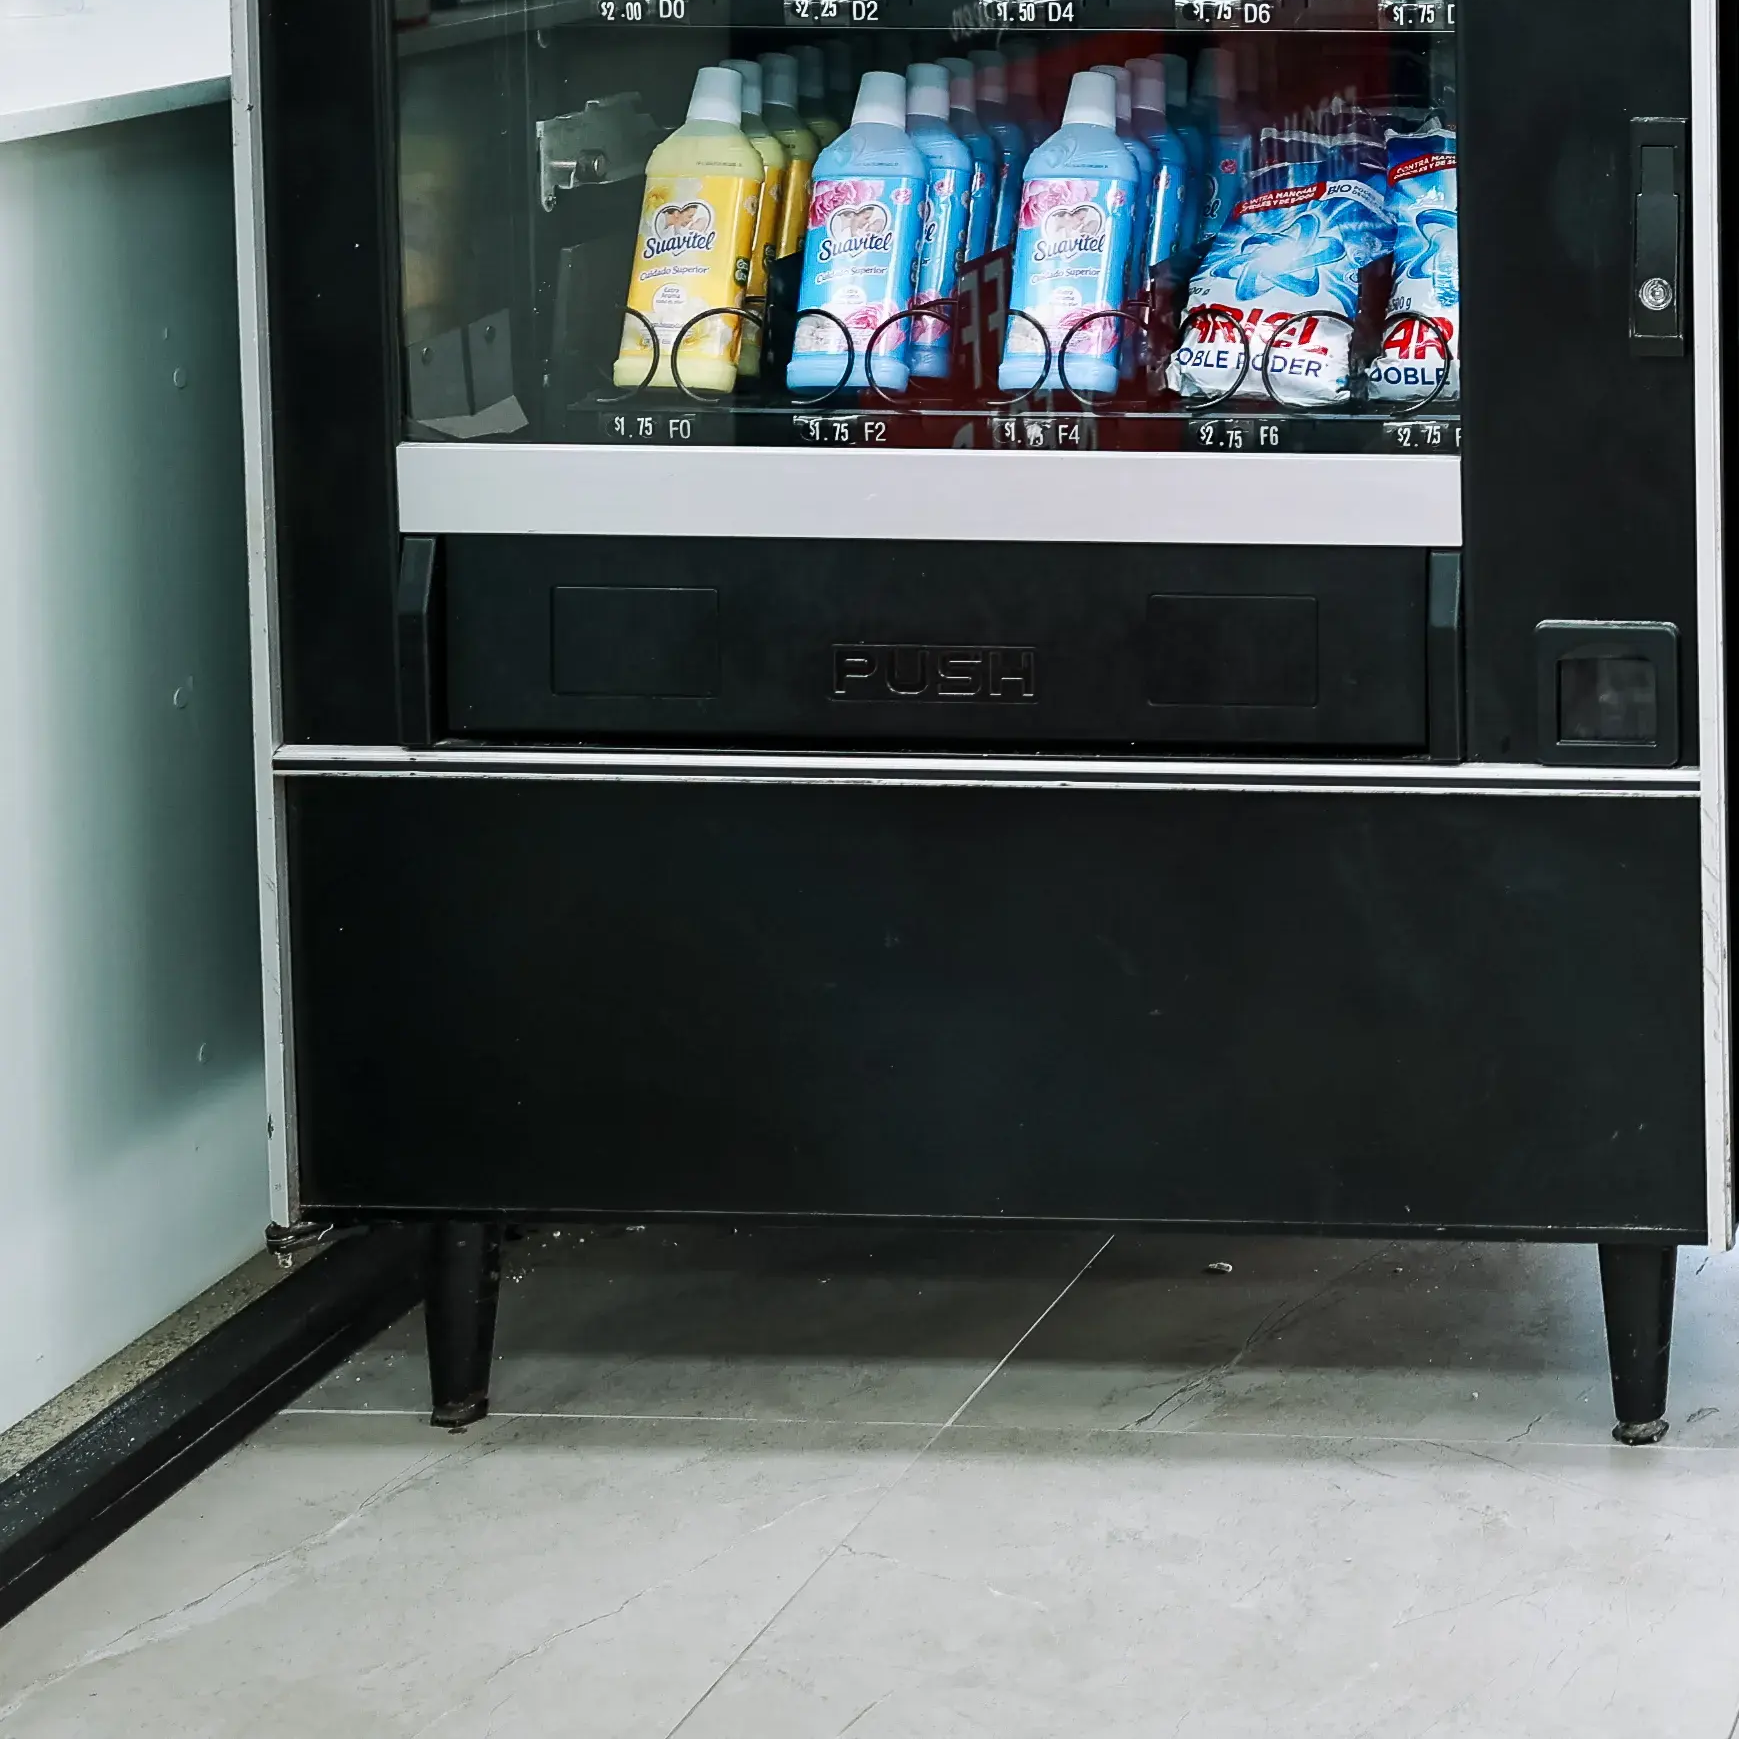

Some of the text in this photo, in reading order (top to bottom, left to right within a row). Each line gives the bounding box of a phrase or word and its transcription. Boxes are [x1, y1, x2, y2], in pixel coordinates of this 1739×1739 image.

[852, 0, 879, 20] D2
[642, 229, 716, 259] Suavitel
[819, 229, 893, 261] Suavitel
[639, 264, 710, 281] Cuidado Superior
[669, 420, 691, 439] F0
[833, 656, 1036, 698] PUSH
